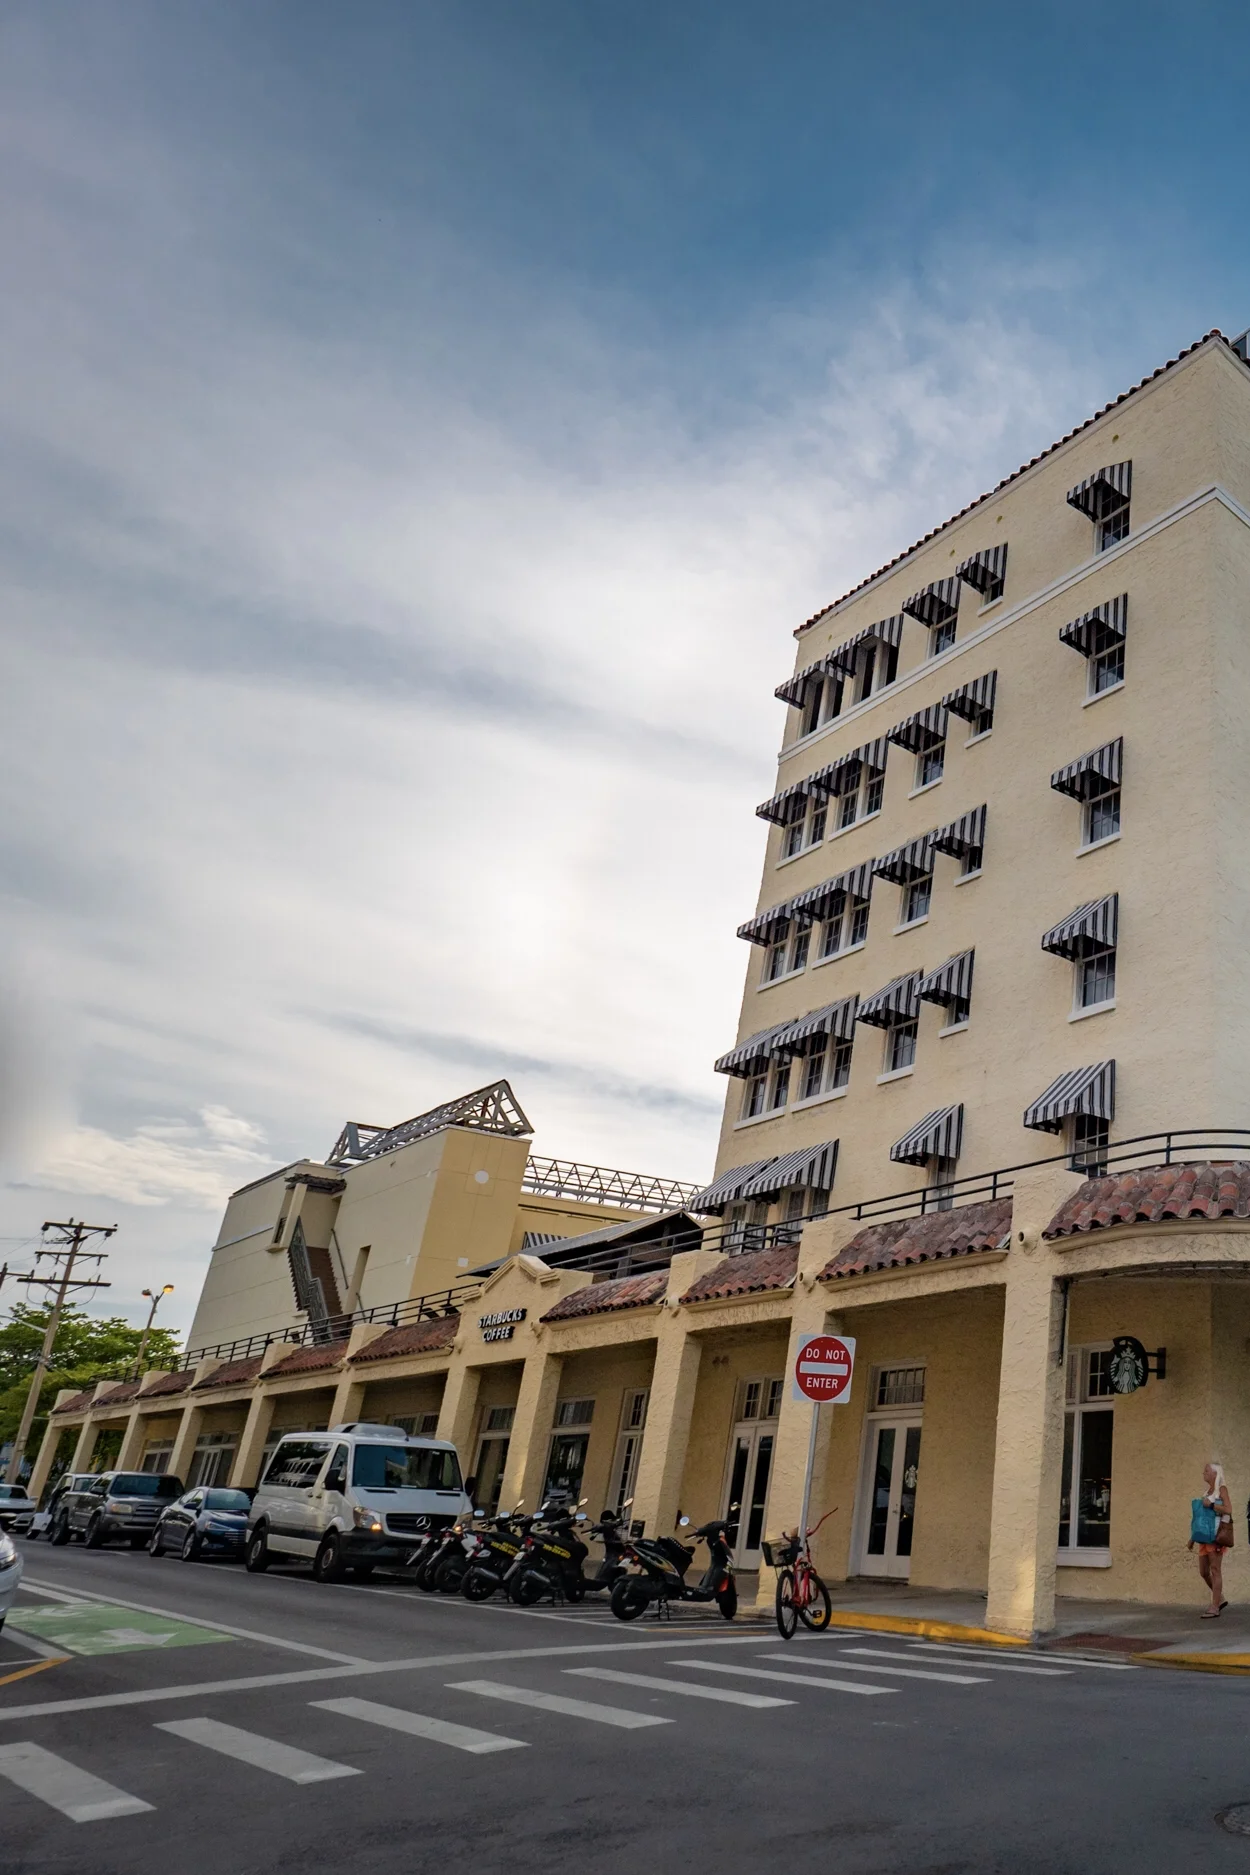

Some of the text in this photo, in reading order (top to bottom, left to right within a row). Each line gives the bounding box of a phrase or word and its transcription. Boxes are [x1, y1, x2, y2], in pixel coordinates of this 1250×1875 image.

[478, 1308, 524, 1328] STARBUCKS
[482, 1326, 513, 1342] COFFEE
[806, 1348, 845, 1360] DO NOT
[806, 1377, 839, 1389] ENTER
